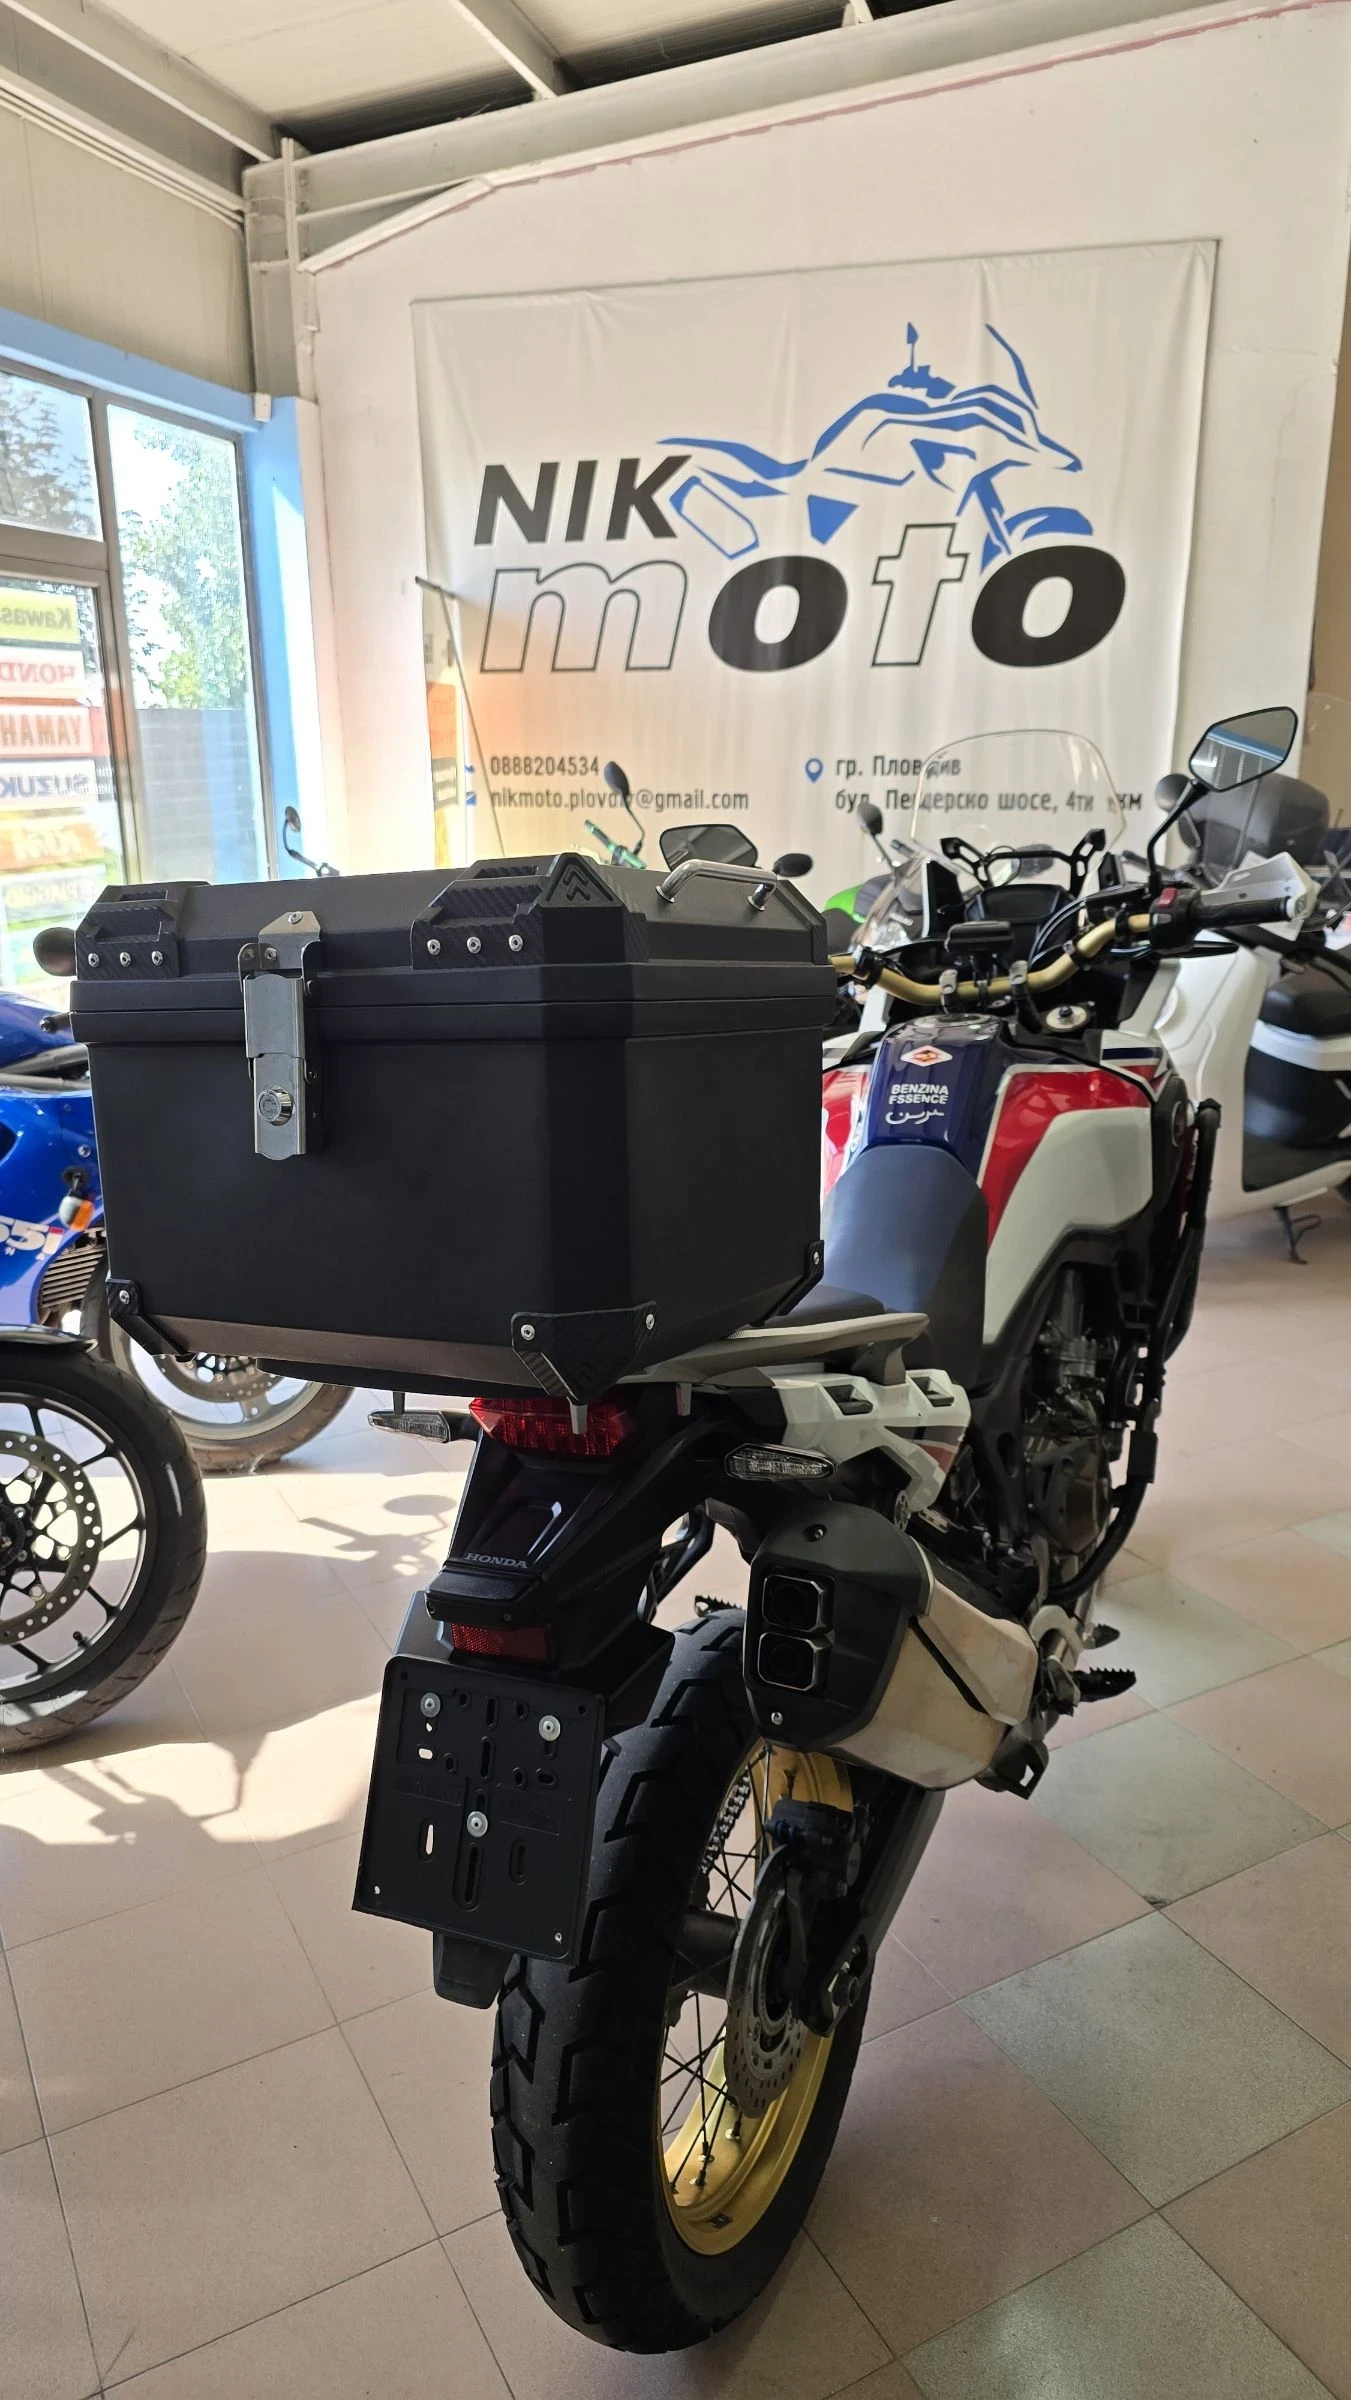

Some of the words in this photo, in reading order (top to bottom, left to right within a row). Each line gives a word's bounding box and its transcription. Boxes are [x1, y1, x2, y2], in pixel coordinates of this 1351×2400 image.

[473, 455, 693, 546] NIK
[479, 523, 1127, 673] moto
[490, 756, 600, 776] 0888204534
[836, 758, 863, 780] гр.
[873, 754, 961, 780] Пловдив
[996, 792, 1058, 814] шосе,
[891, 1083, 949, 1095] BENZINA
[464, 1552, 528, 1569] HONDA
